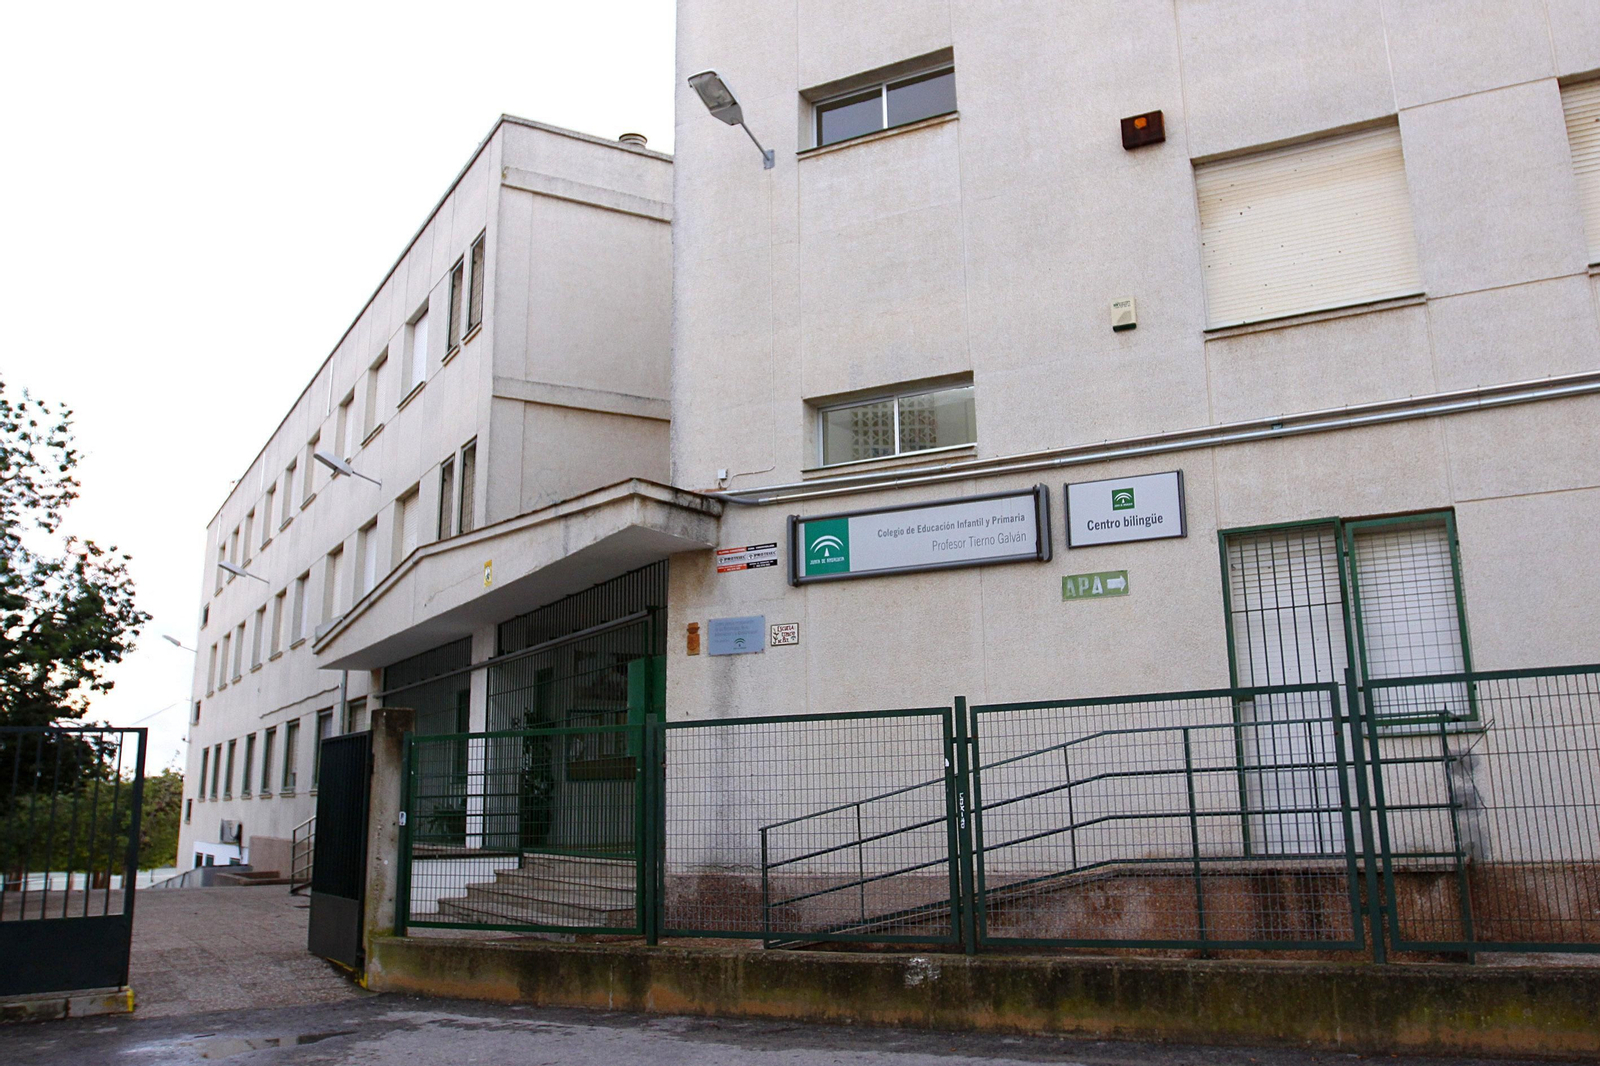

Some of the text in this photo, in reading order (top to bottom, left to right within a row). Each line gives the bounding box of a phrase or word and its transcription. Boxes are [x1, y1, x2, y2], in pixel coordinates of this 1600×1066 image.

[877, 513, 1026, 538] Colegio de Educación Infantil y Primaria
[1087, 513, 1164, 531] Centro bilingüe
[932, 531, 1027, 551] Profesor Tierno Galván
[1066, 575, 1104, 597] APA
